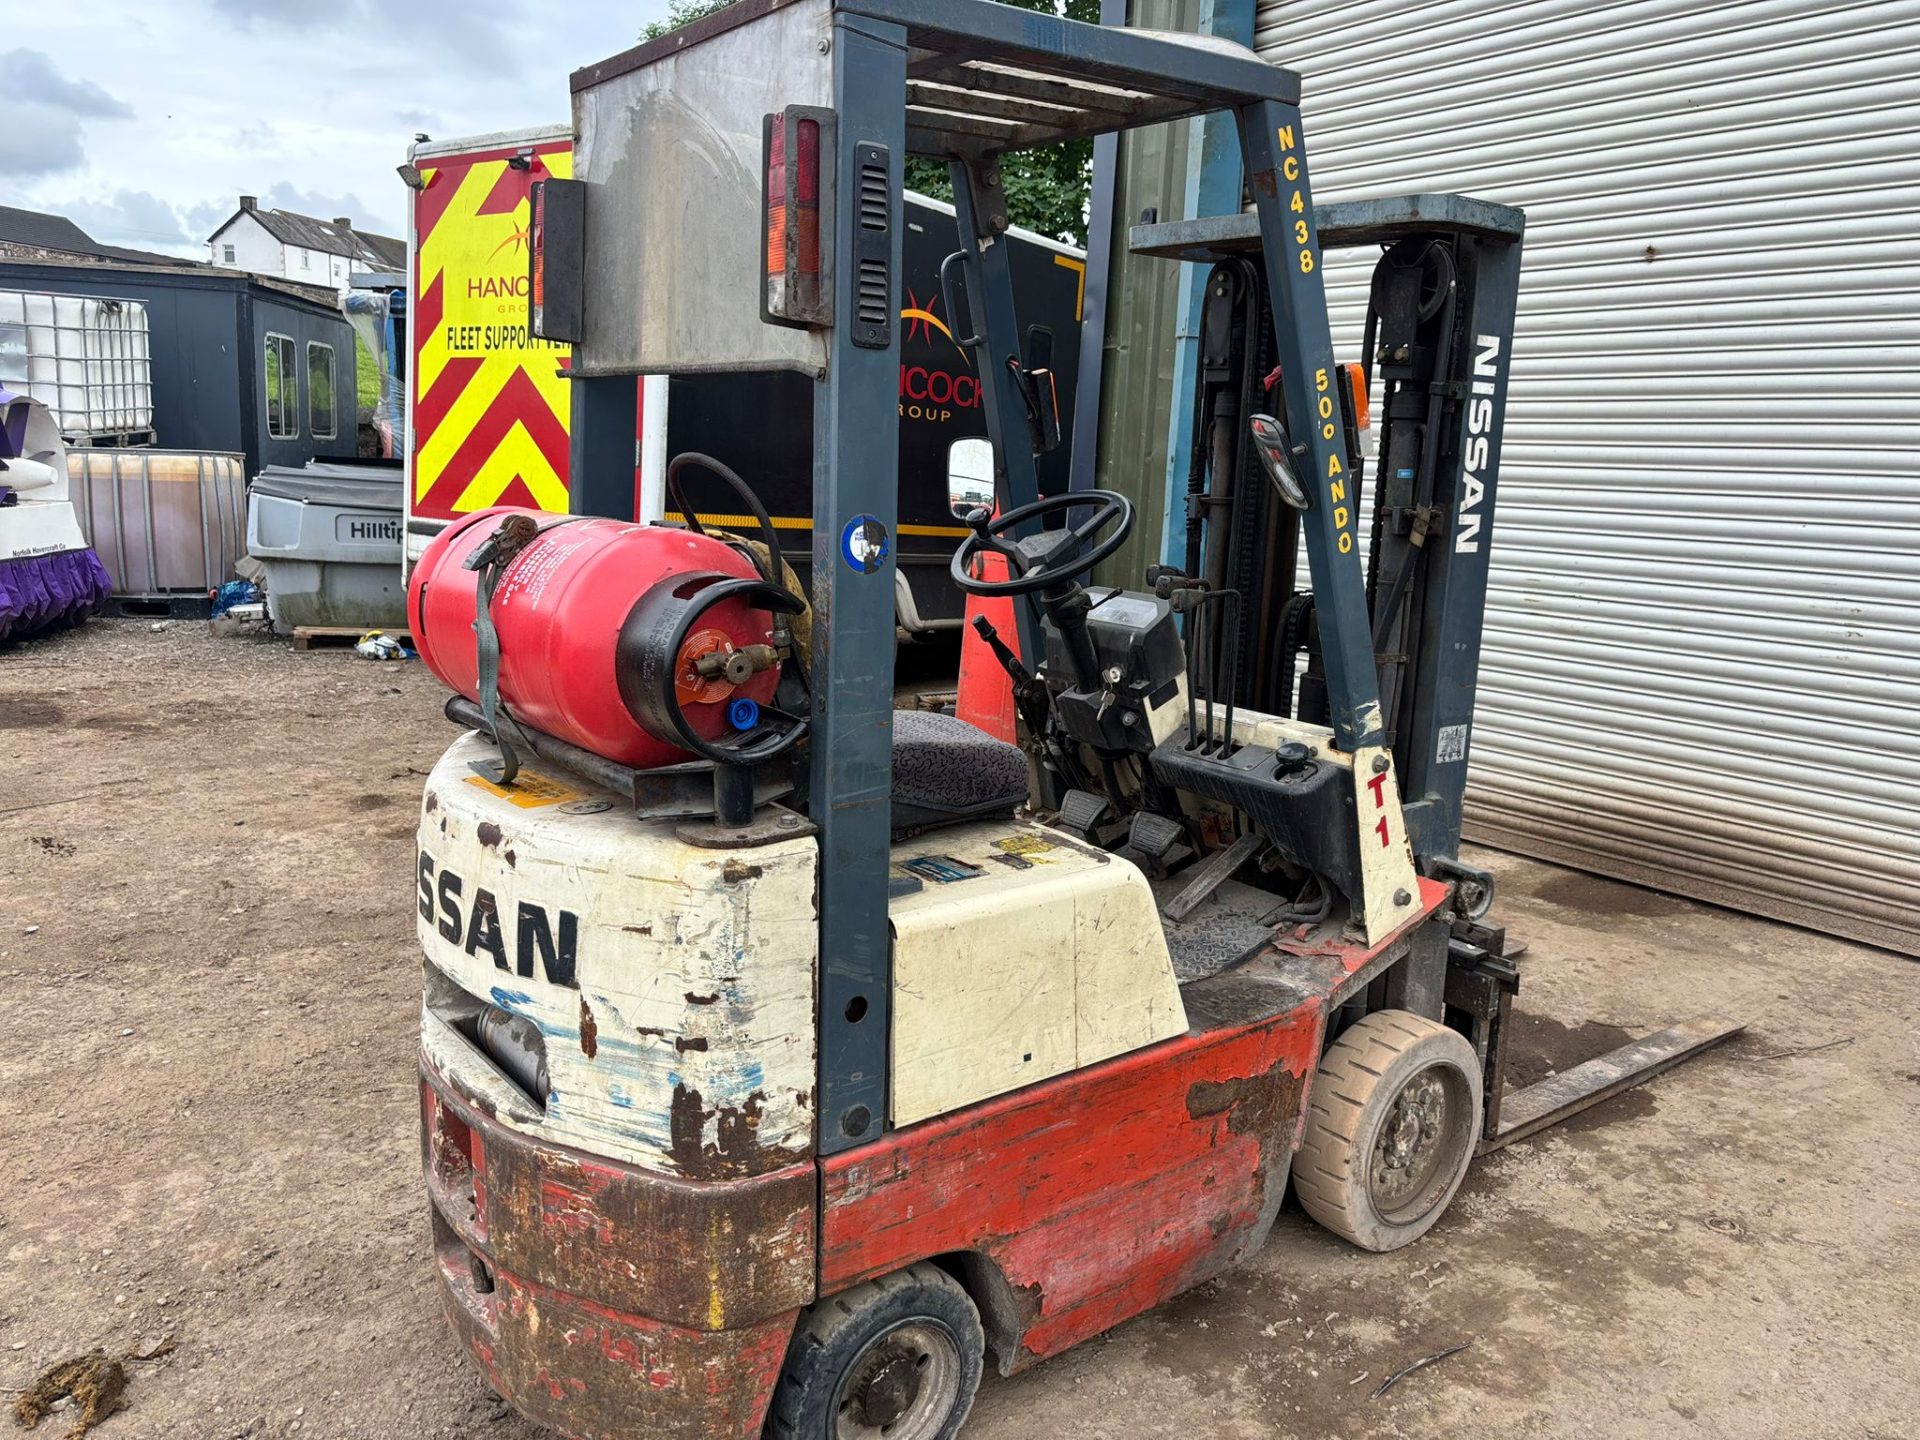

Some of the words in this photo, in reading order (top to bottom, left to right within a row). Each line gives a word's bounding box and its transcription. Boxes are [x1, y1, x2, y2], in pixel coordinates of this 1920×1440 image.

[497, 303, 528, 313] GRO
[447, 326, 481, 350] FLEET
[1455, 334, 1500, 554] NISSAN
[1328, 453, 1352, 554] ANDO
[12, 548, 32, 557] Norfolk
[32, 544, 59, 553] Hovercraft
[501, 583, 515, 606] GAS
[419, 850, 581, 990] SSAN
